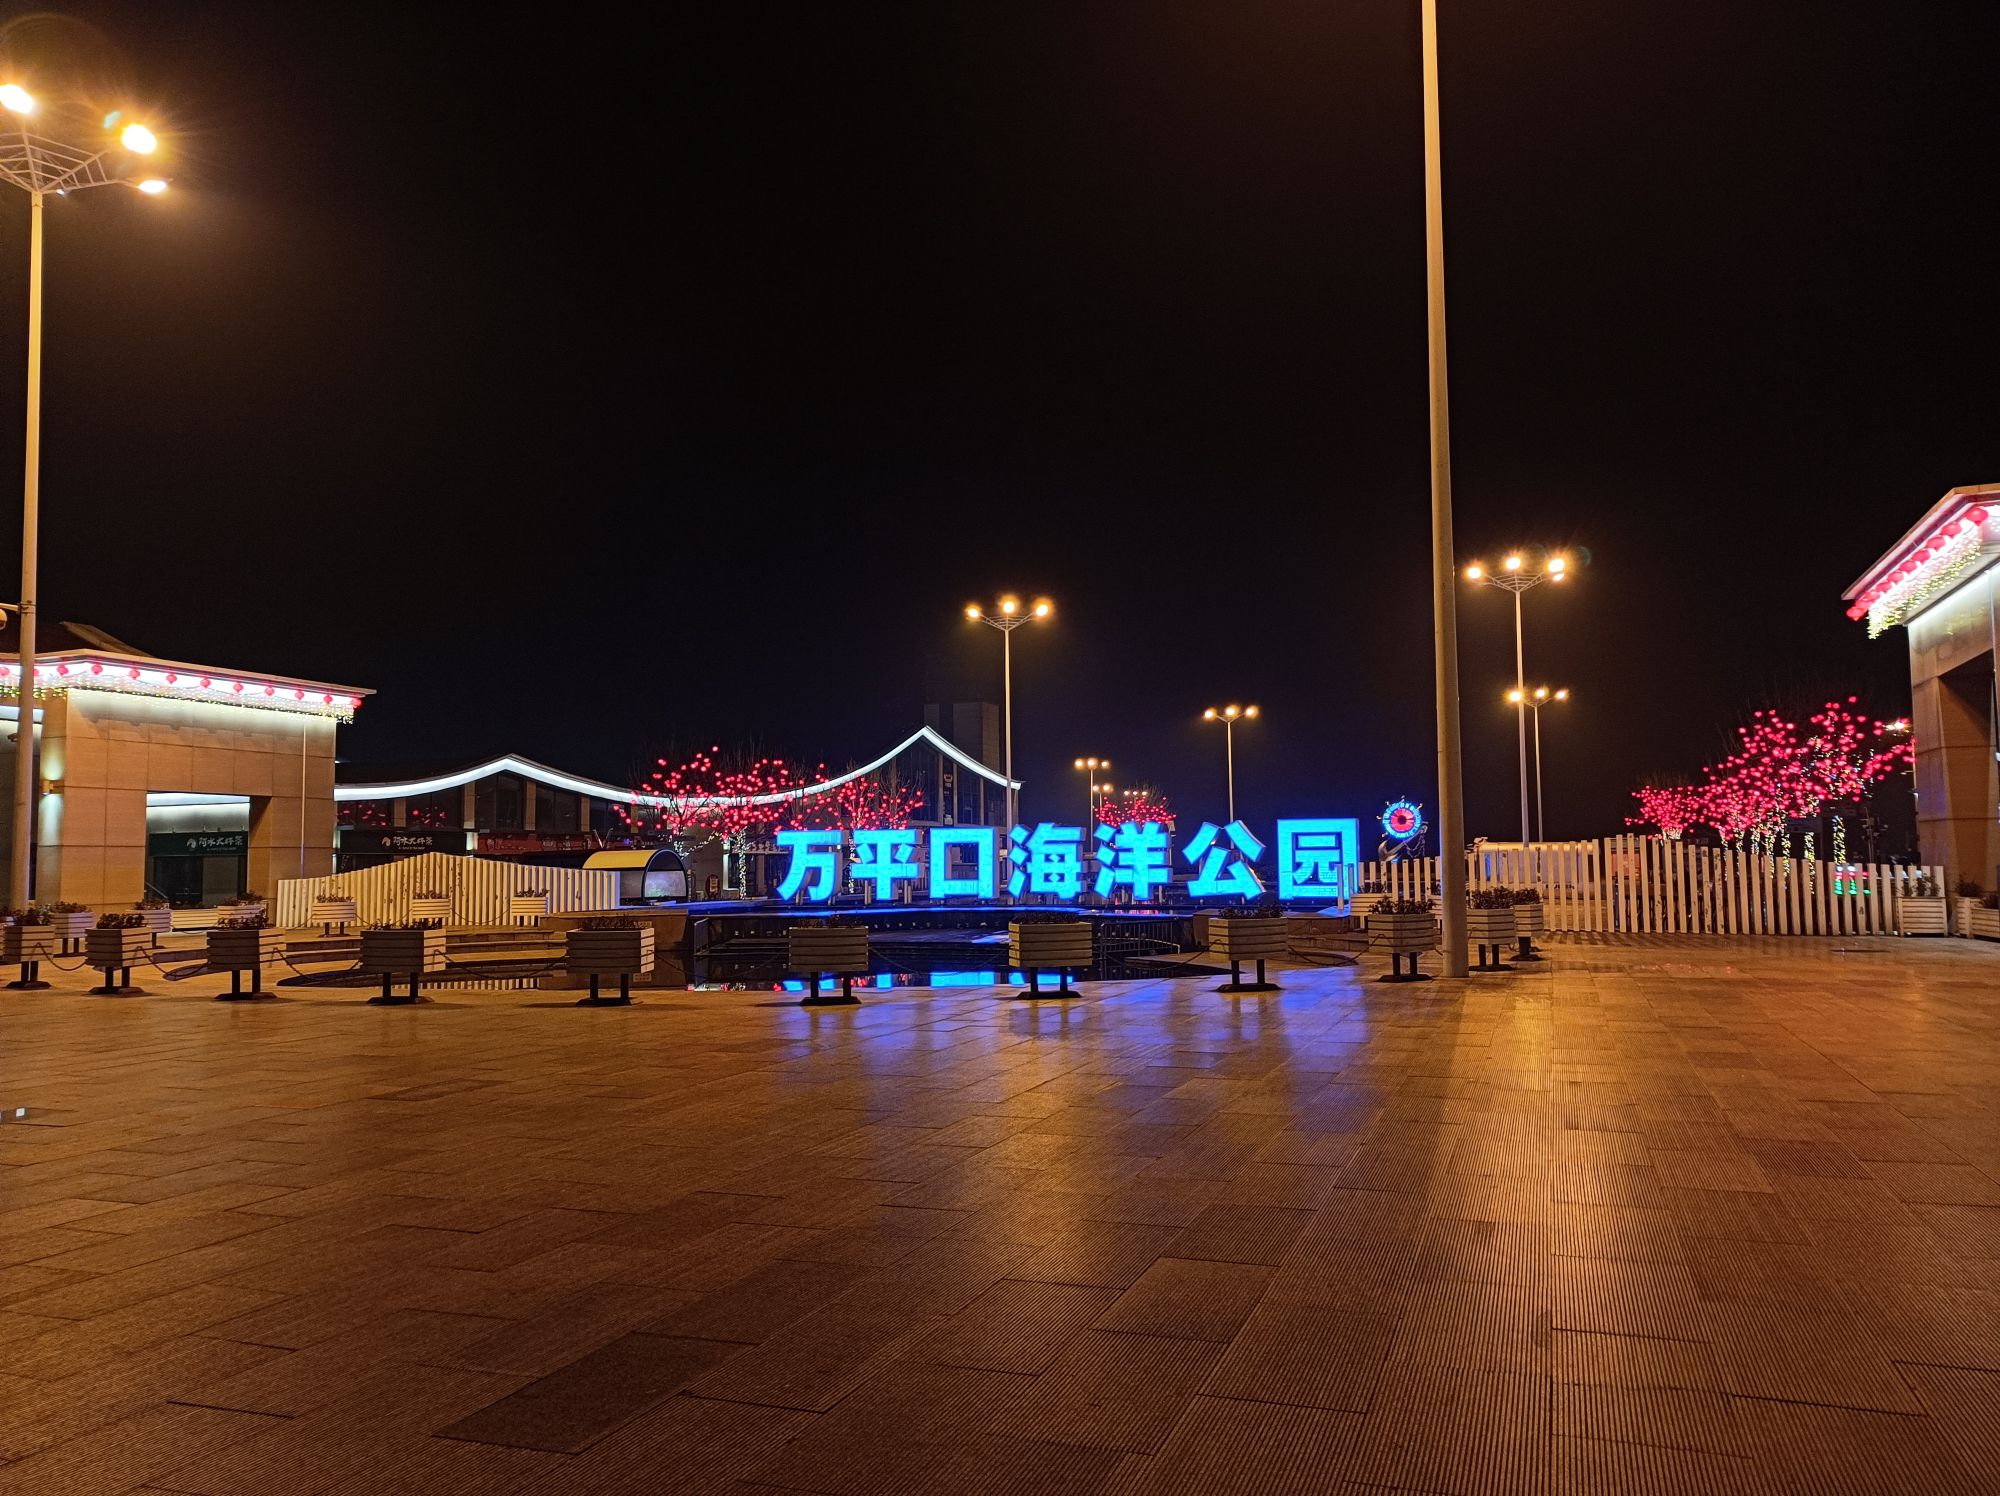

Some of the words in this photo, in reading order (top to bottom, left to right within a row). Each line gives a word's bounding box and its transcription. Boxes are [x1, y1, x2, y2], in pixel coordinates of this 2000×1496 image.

[777, 818, 1359, 901] 万平口海洋公园
